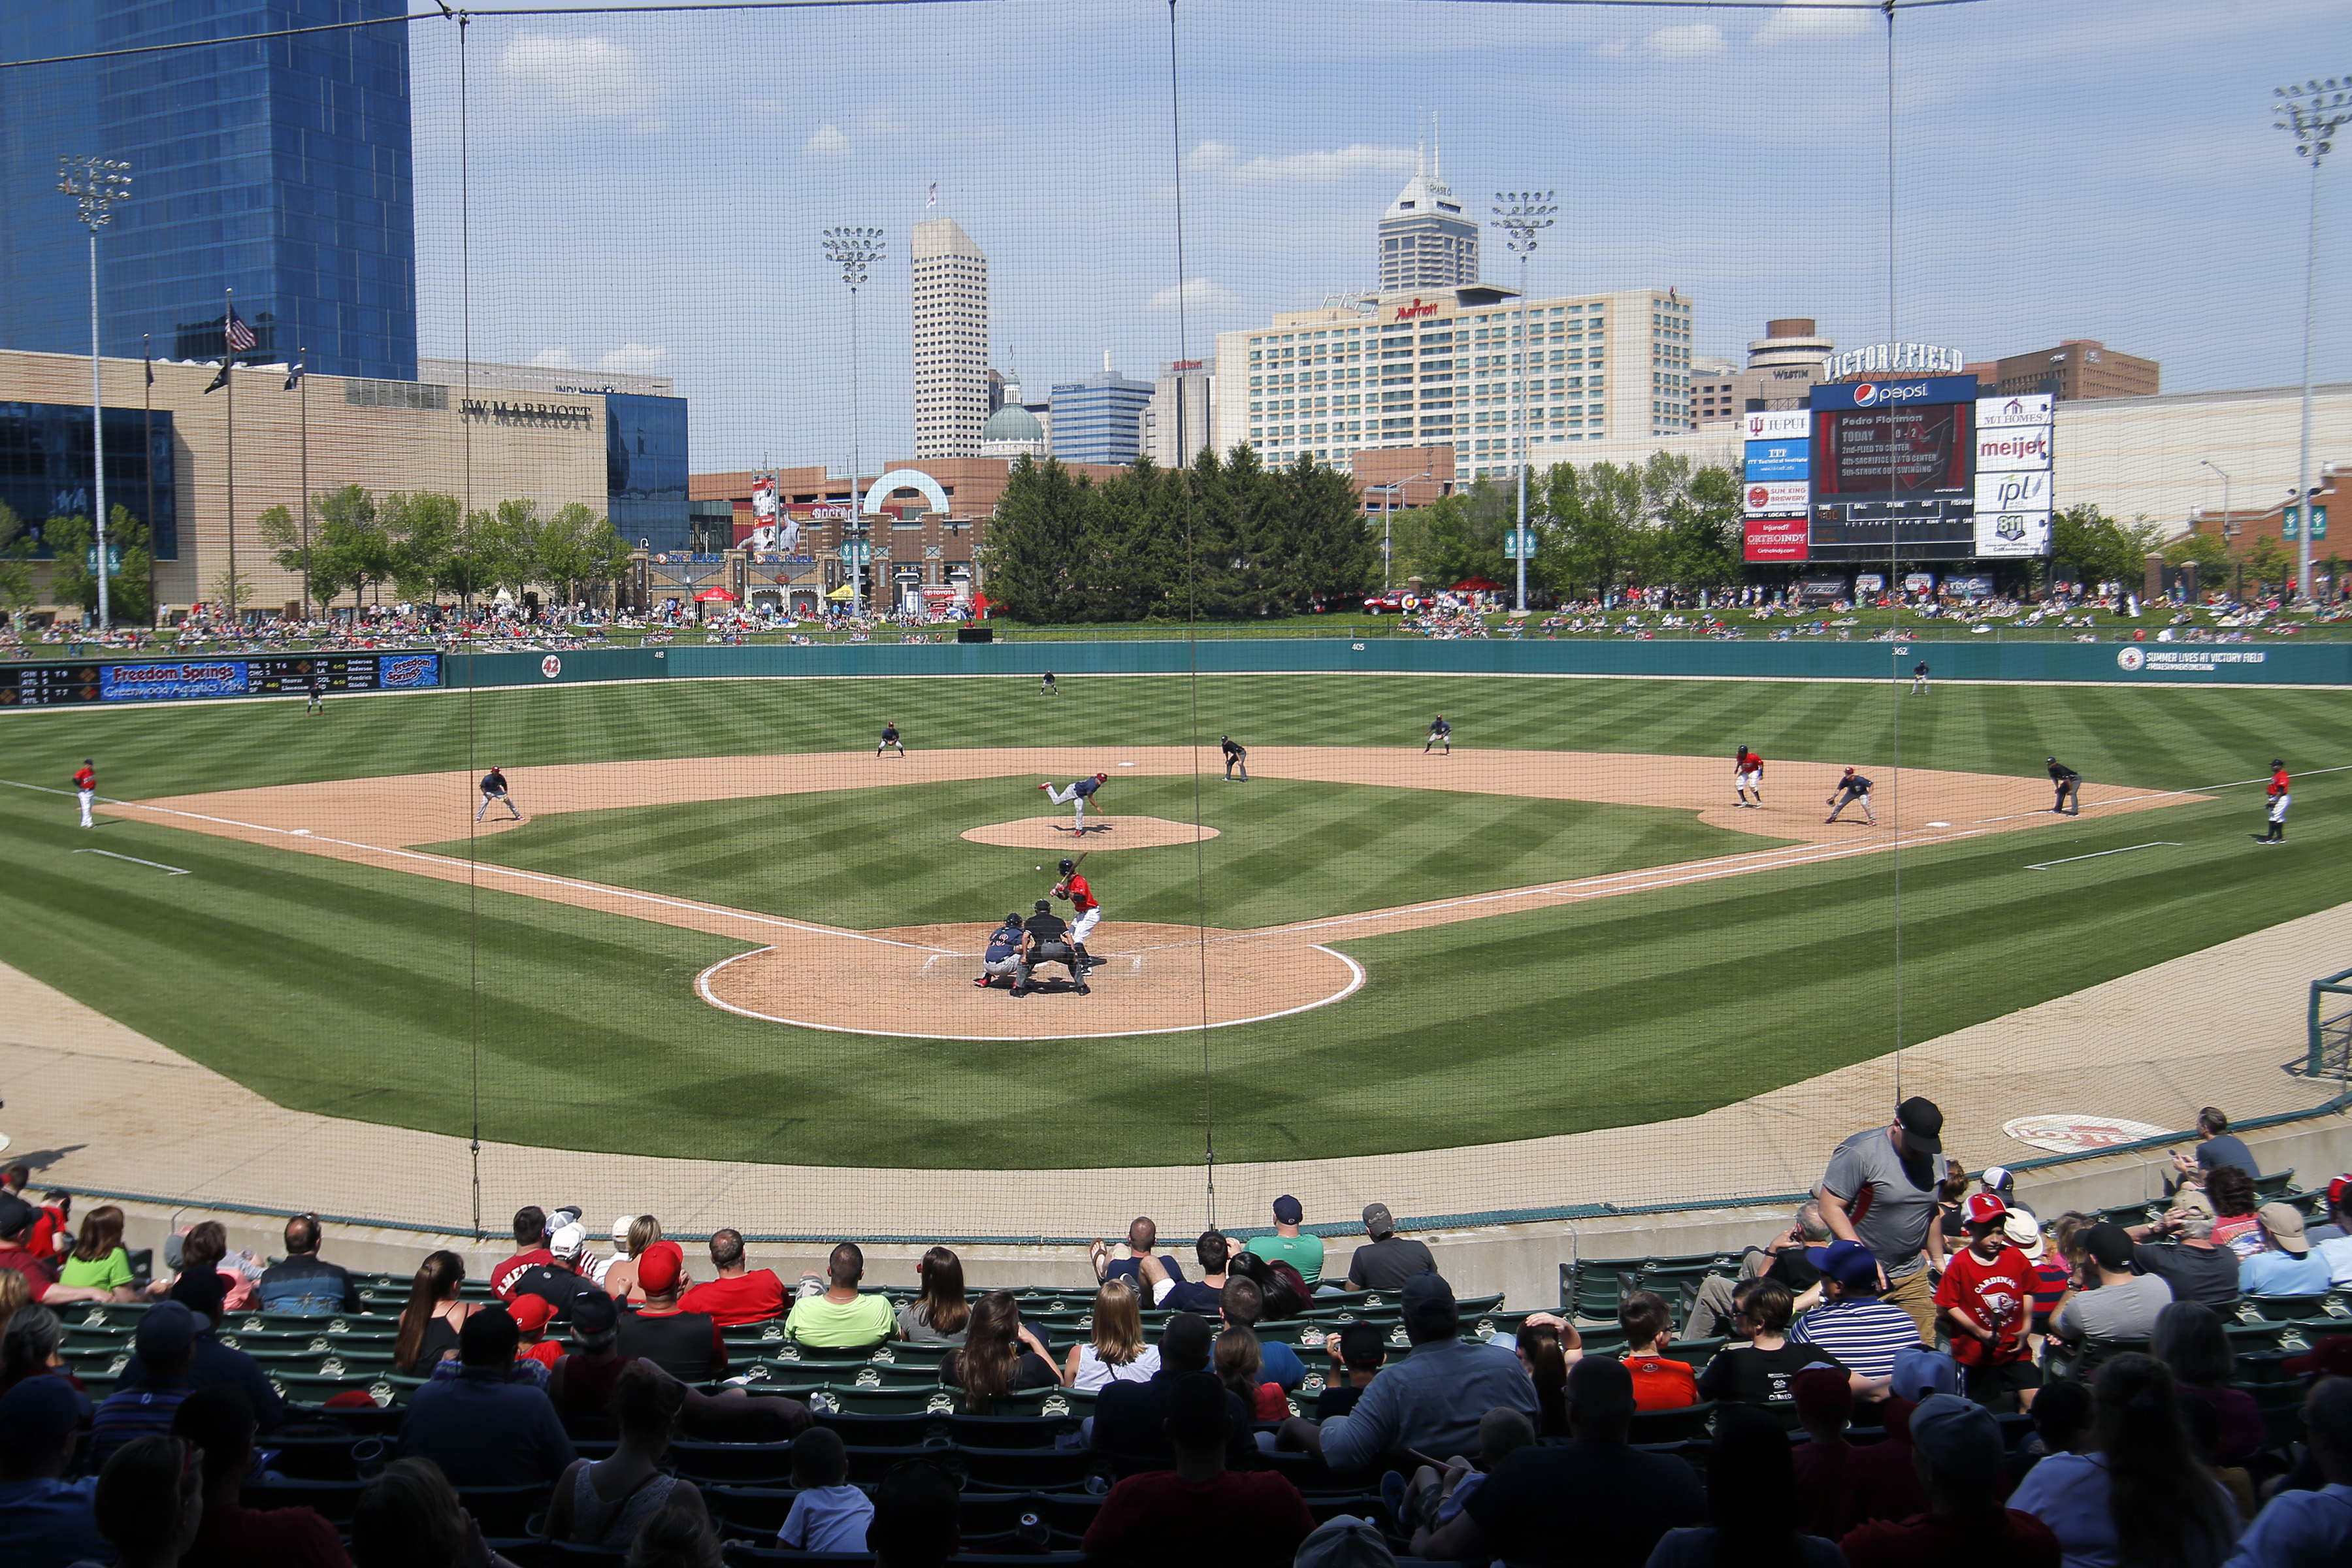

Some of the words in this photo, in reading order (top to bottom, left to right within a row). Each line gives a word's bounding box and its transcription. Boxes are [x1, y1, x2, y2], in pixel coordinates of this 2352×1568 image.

[1429, 184, 1446, 195] CHASE
[1173, 361, 1202, 370] Hilton
[1821, 342, 1901, 383] VICTORY
[1906, 342, 1964, 373] FIELD
[1879, 383, 1927, 402] pepsi
[459, 399, 487, 414] JW
[492, 400, 591, 421] MARRIOTT
[1769, 418, 1805, 430] IUPUI
[1842, 416, 1872, 426] Pedro
[1876, 414, 1923, 423] Florimon
[2004, 414, 2043, 423] HOMES
[1842, 431, 1874, 442] TODAY
[1911, 429, 1917, 437] 2
[1768, 449, 1787, 458] ITT
[1842, 446, 1874, 454] 2nd-FLIED
[1980, 436, 2046, 459] meijer
[1841, 457, 1889, 466] 4th-SACRIFICE
[1912, 453, 1936, 462] CENTER
[1841, 468, 1882, 476] 5th-STRUCK
[1897, 465, 1932, 474] SWINGING
[1997, 515, 2023, 532] 811
[1747, 534, 1806, 543] ORTHOINDY
[2146, 652, 2177, 662] SUMMER
[2178, 653, 2198, 662] LIVES
[2199, 652, 2209, 662] AT
[2211, 652, 2242, 663] VICTORY
[2242, 652, 2264, 663] FIELD
[393, 657, 431, 672] Freedom
[543, 660, 559, 672] 42
[112, 665, 178, 682] Freedom
[180, 663, 235, 682] Springs
[386, 666, 421, 683] Springs
[103, 685, 169, 698] Greenwood
[170, 682, 218, 697] Aquatics
